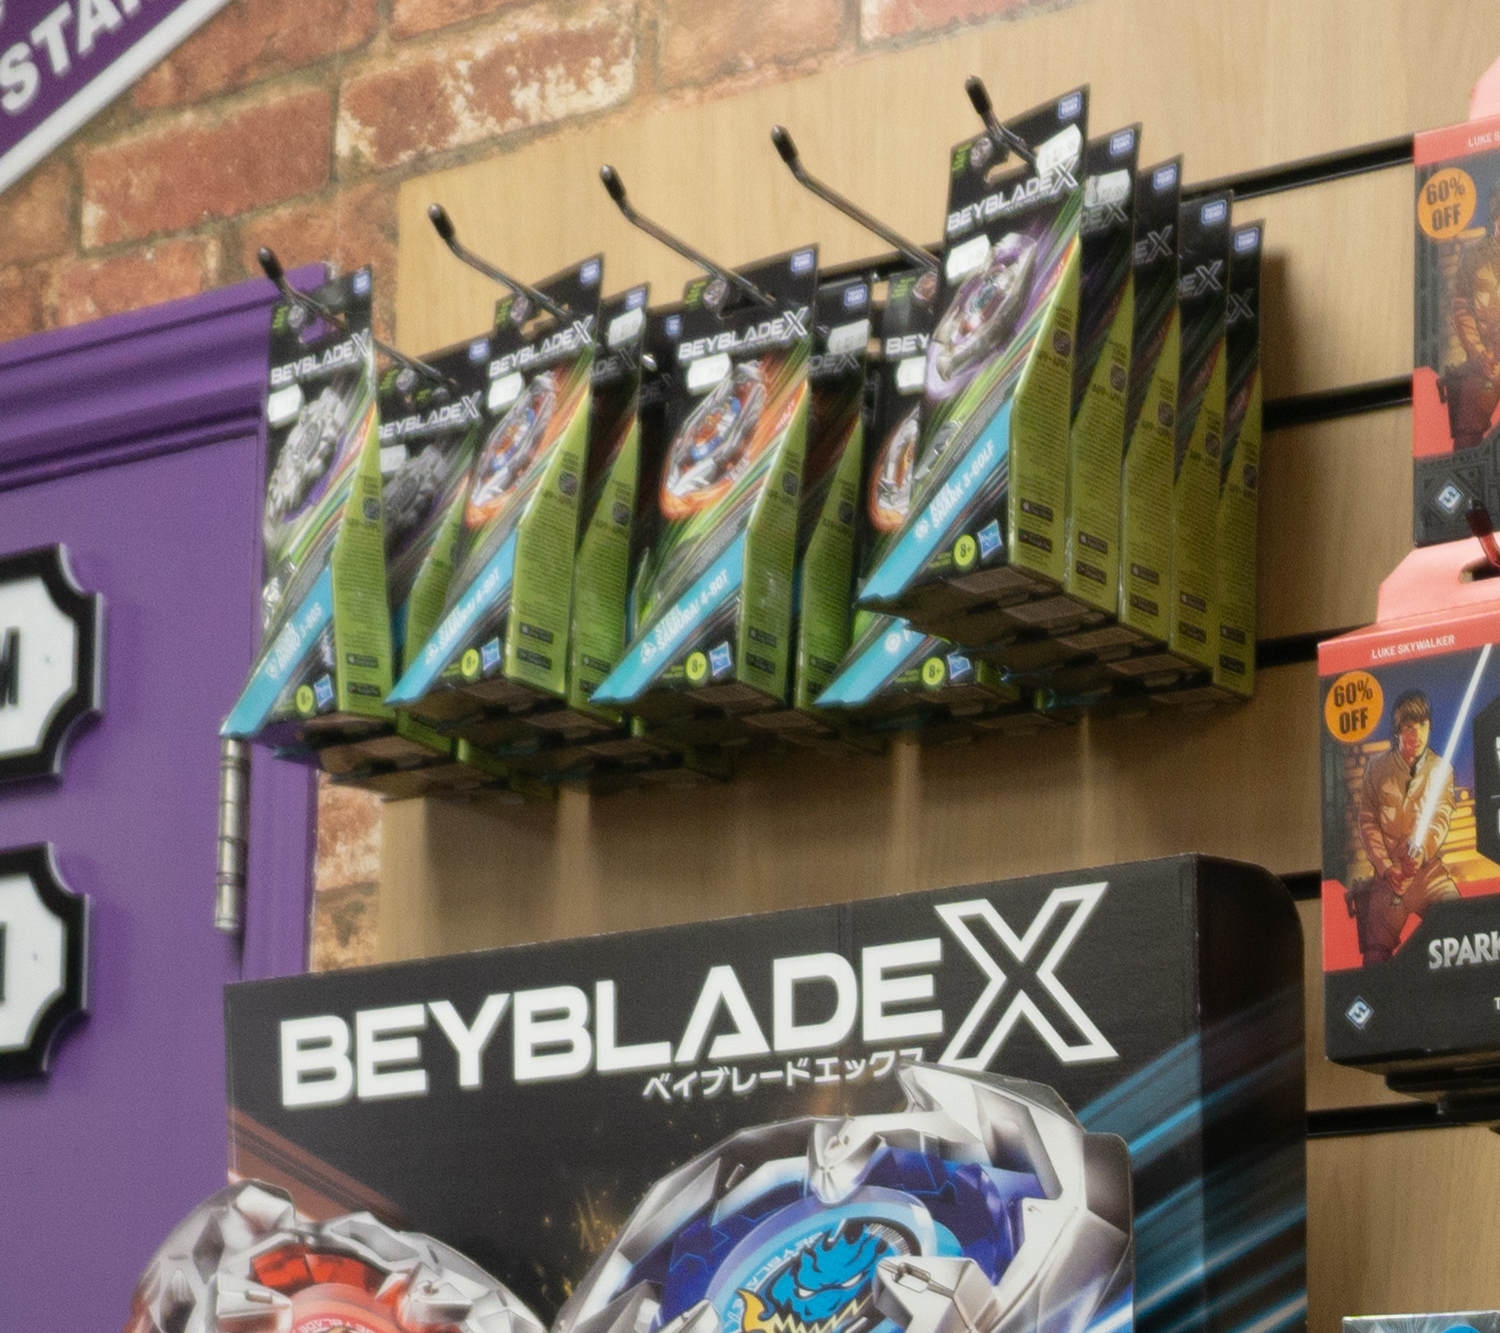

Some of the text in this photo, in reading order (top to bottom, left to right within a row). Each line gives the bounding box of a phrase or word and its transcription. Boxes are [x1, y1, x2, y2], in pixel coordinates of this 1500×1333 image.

[1467, 130, 1493, 148] LUKE
[1425, 174, 1466, 206] 60%
[1431, 203, 1461, 231] OFF
[1371, 633, 1457, 661] LUKE SKYWALKER
[1332, 677, 1375, 710] 60%
[1338, 705, 1370, 737] OFF
